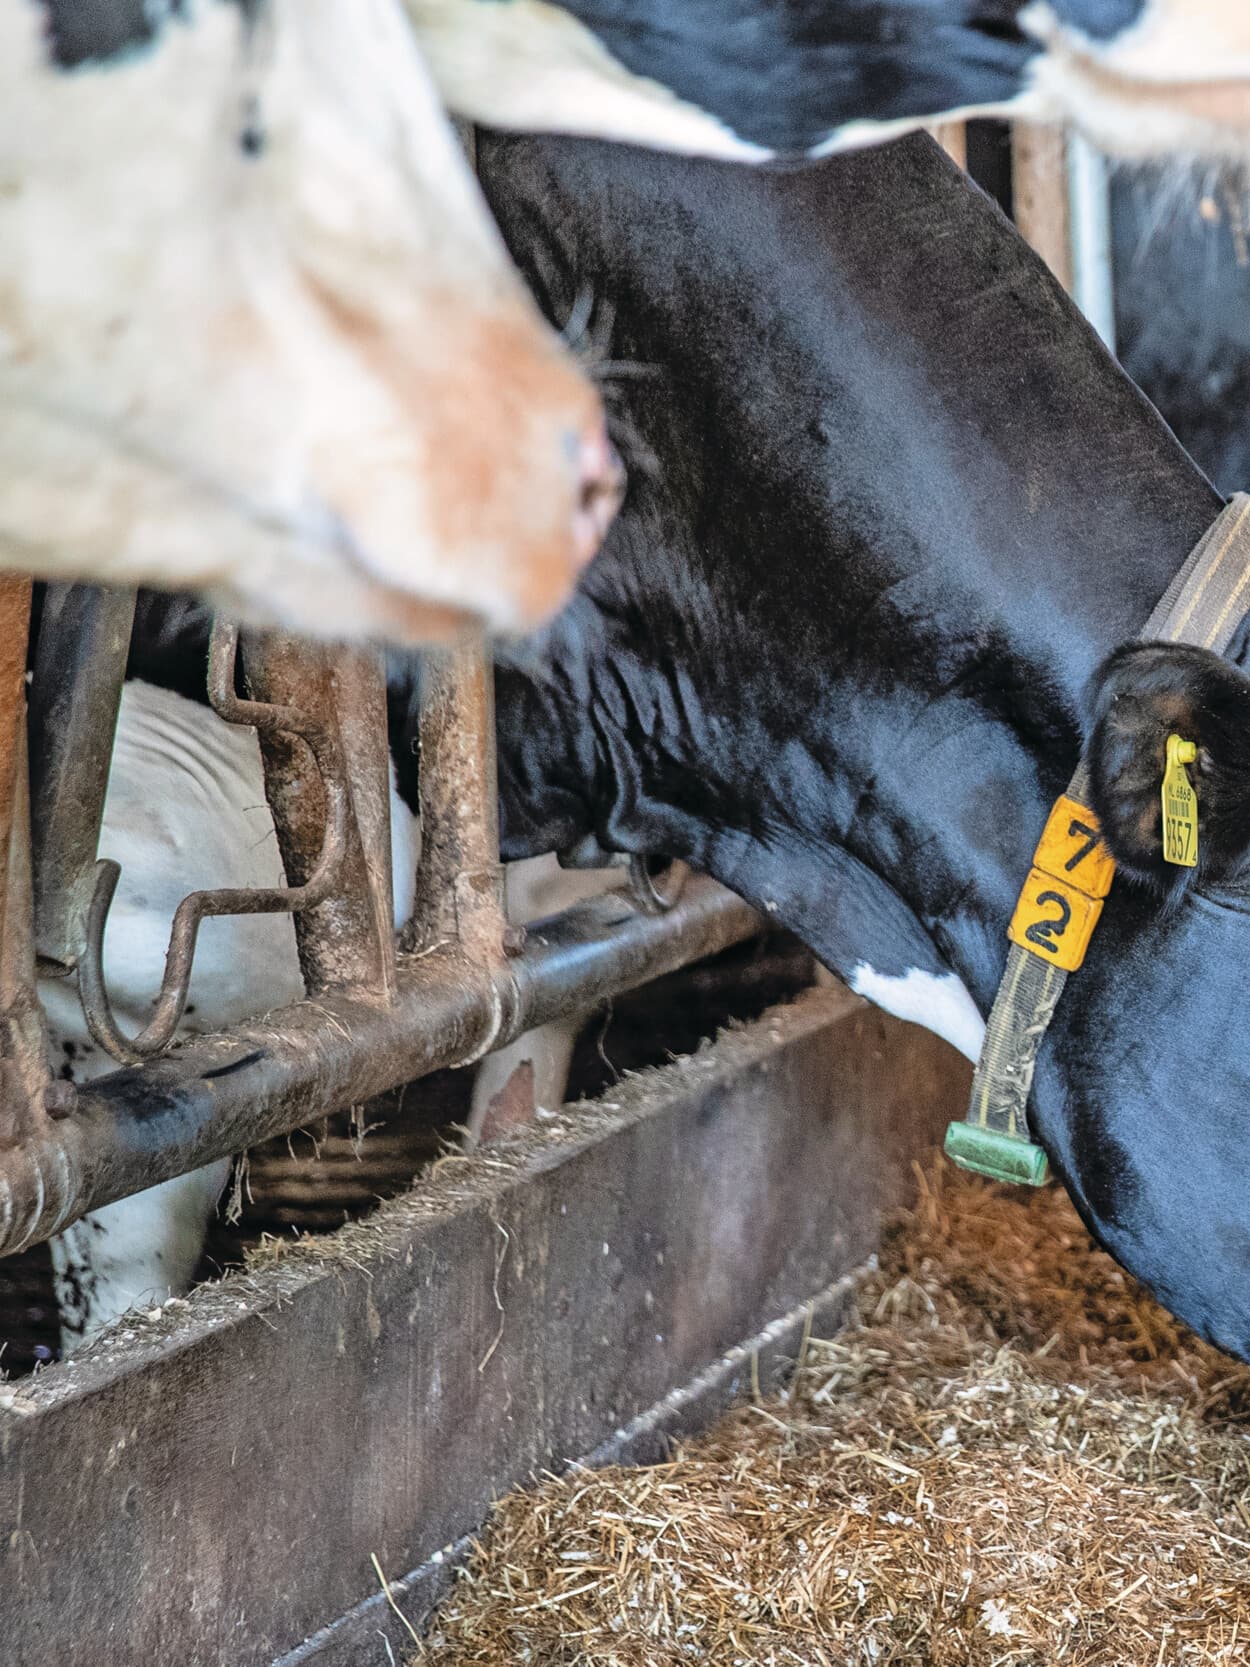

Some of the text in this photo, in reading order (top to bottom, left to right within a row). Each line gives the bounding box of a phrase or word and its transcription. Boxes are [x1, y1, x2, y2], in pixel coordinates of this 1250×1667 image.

[1065, 819, 1100, 872] 7
[1167, 817, 1192, 862] 9357
[1025, 890, 1071, 954] 2
